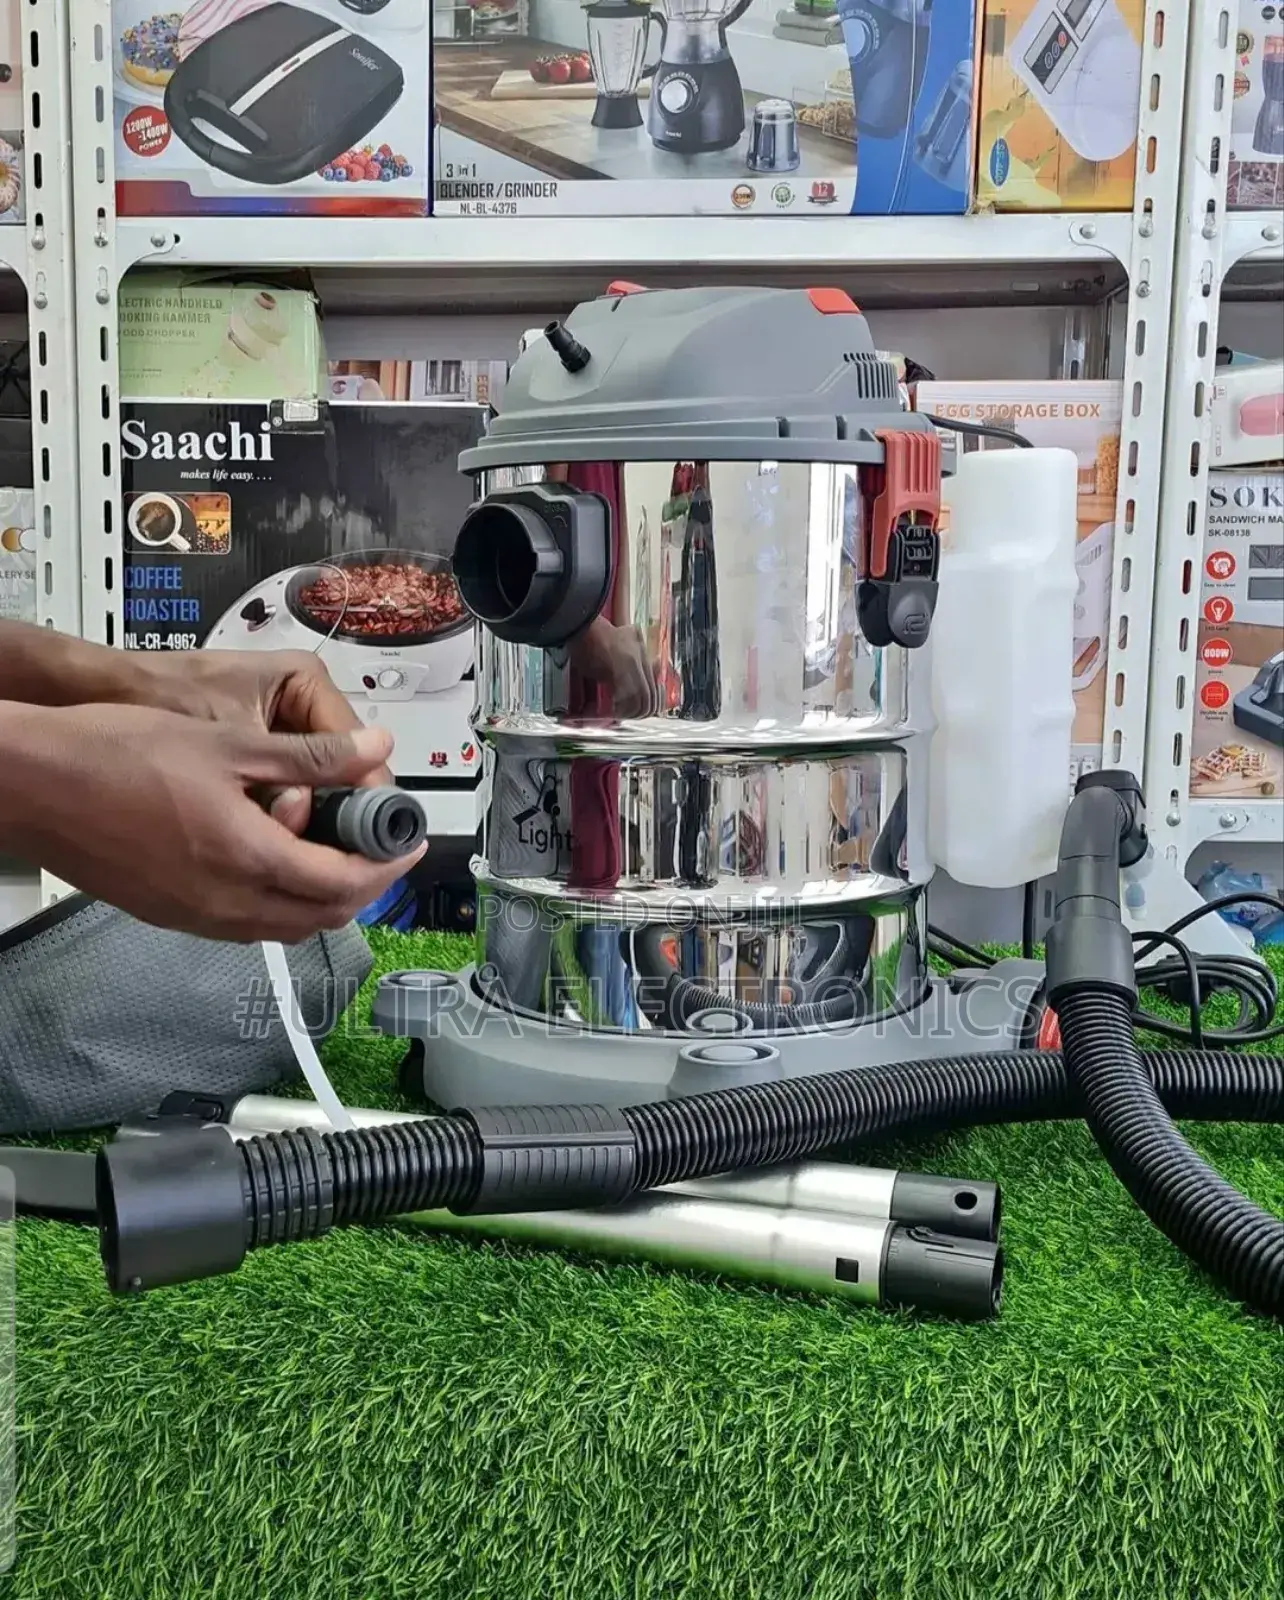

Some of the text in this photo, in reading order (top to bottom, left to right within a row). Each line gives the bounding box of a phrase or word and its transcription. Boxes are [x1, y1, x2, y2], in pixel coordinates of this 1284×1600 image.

[126, 115, 153, 135] 1200W
[446, 163, 454, 178] 3
[472, 163, 477, 178] 1
[165, 298, 223, 309] HANDHELD
[163, 312, 212, 324] HAMMER
[147, 329, 196, 339] CHOPPER
[935, 403, 1101, 418] EGG STORAGE BOX
[121, 419, 274, 461] Saachi
[180, 469, 210, 480] makes
[212, 468, 228, 482] life
[1209, 486, 1284, 508] SOK
[1208, 515, 1284, 524] SANDWICH MA
[124, 566, 183, 590] COFFEE
[124, 598, 200, 622] ROASTER
[124, 632, 197, 650] NL-CR-4962
[1204, 648, 1230, 659] 800W
[518, 821, 575, 854] Light
